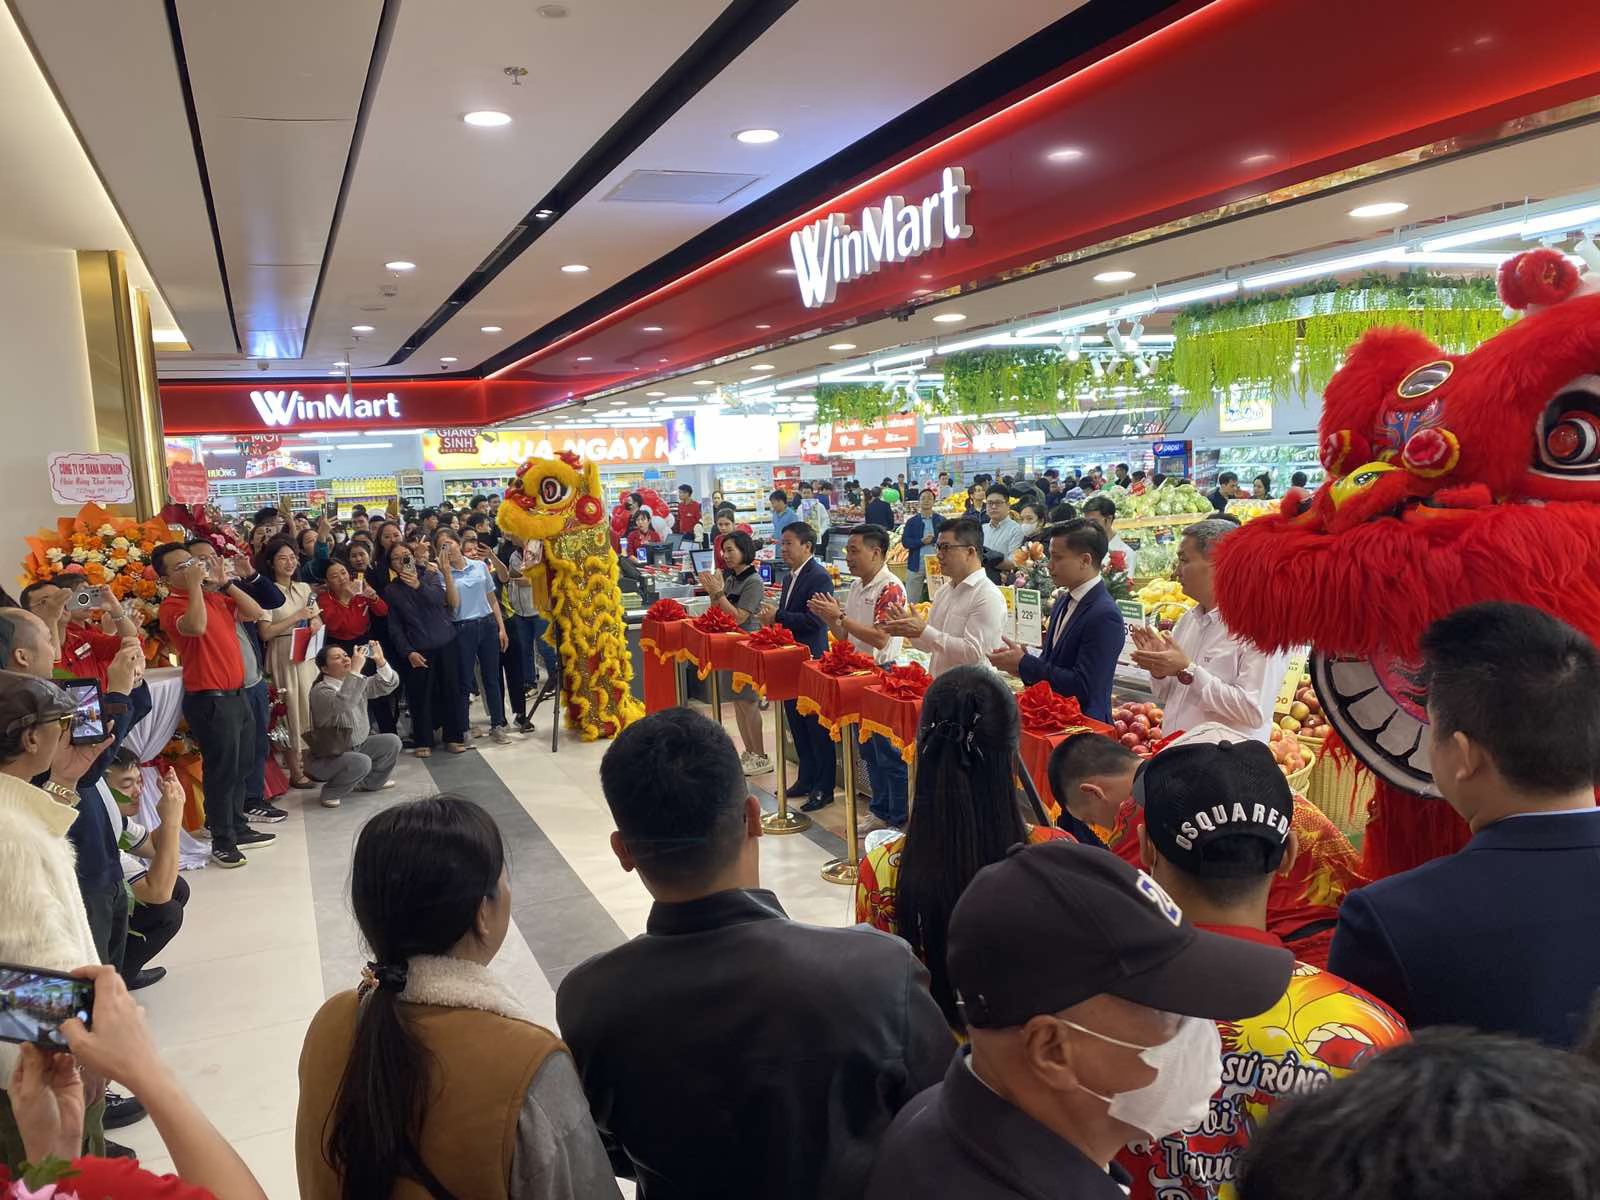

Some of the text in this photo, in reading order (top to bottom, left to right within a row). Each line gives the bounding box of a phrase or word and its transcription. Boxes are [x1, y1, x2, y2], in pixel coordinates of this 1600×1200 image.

[790, 167, 972, 308] WinMart
[250, 390, 400, 426] WinMart
[444, 437, 473, 448] SINH
[480, 438, 553, 465] MUA
[563, 437, 648, 460] NGAY
[1164, 442, 1180, 452] pepsi
[1222, 1053, 1259, 1086] SƯ
